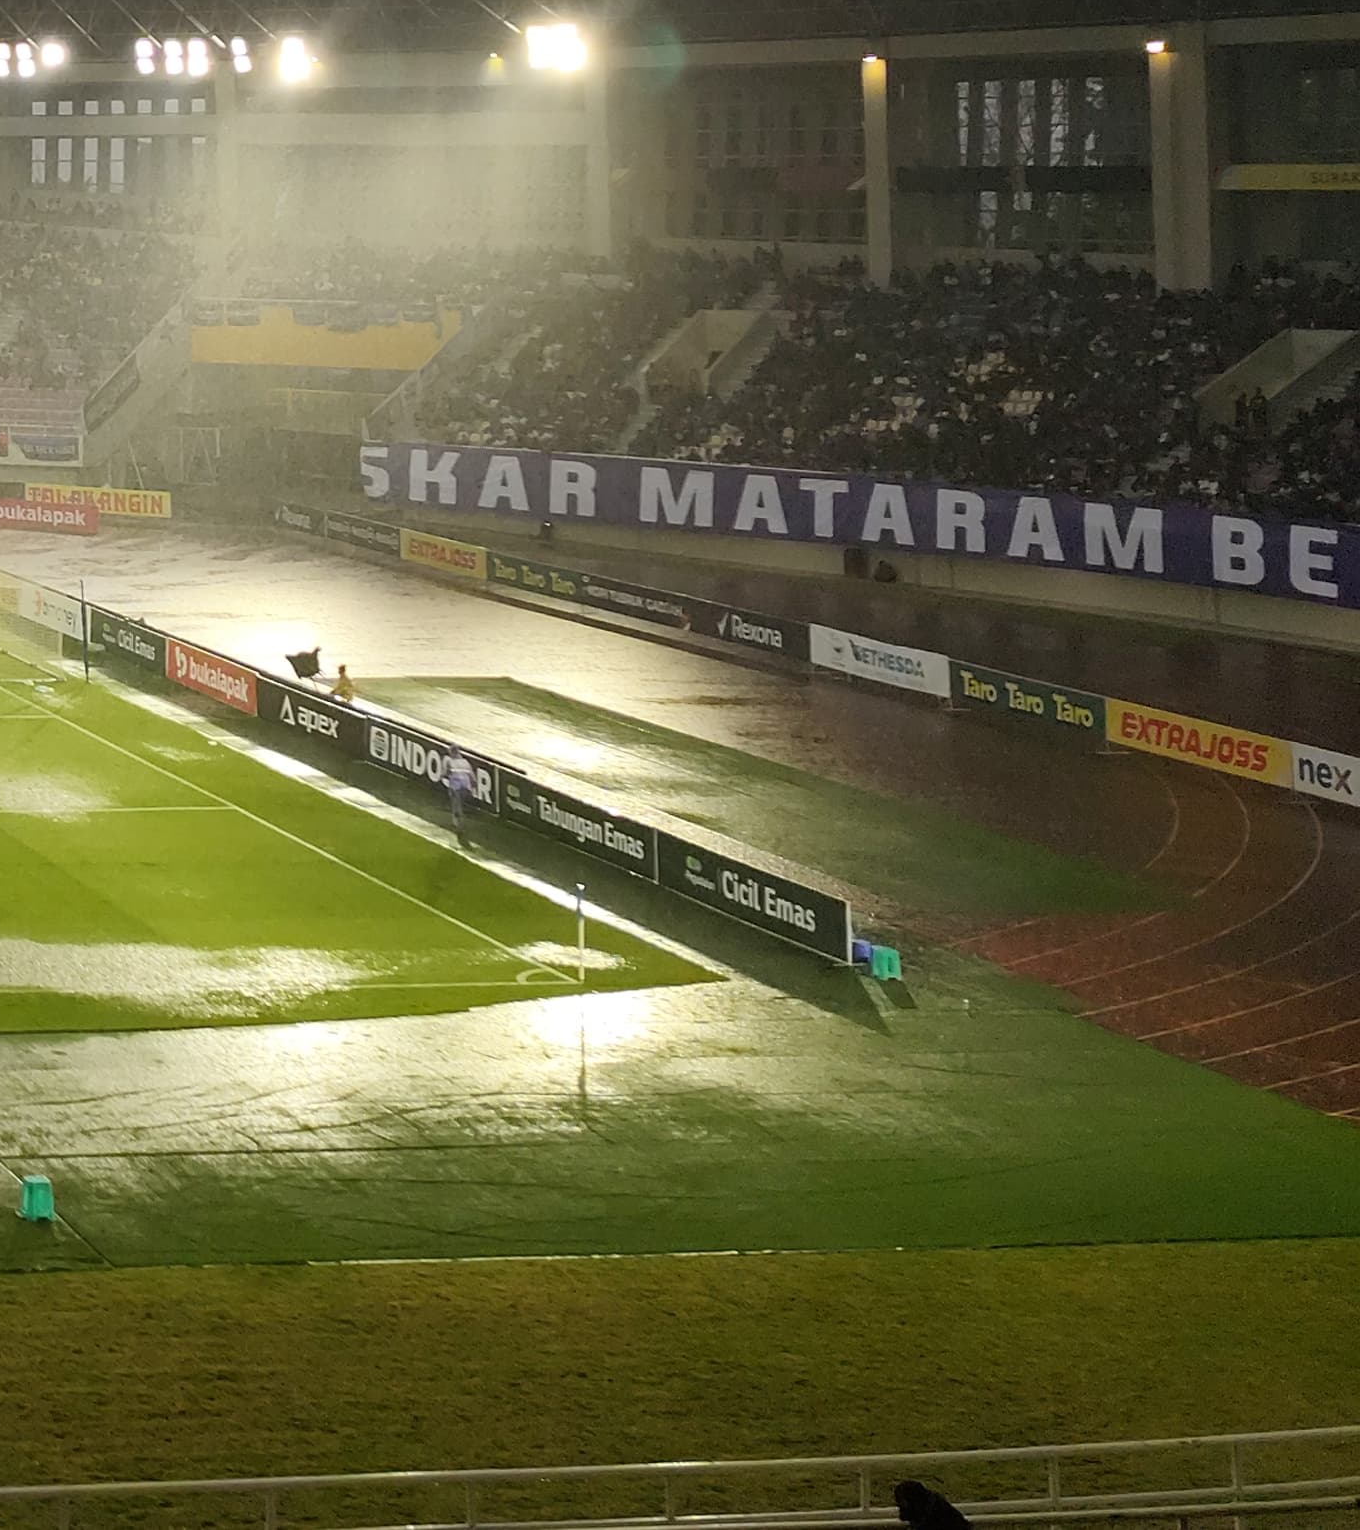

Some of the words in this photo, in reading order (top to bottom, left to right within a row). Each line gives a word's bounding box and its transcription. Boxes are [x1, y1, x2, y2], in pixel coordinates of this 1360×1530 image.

[640, 466, 1164, 573] MATARAM
[1211, 514, 1339, 599] BE
[117, 629, 134, 652] Cicil
[135, 635, 155, 661] Emas
[732, 615, 782, 648] Rexona
[189, 657, 248, 703] bukalapak
[959, 670, 997, 703] Taro
[1004, 682, 1044, 715] Taro
[1053, 693, 1094, 728] Taro
[298, 706, 339, 738] apex
[1120, 711, 1268, 772] EXTRAJOSS
[1298, 756, 1353, 795] nex
[536, 795, 603, 843] Tabungan
[603, 822, 644, 859] Emas
[722, 871, 761, 911] Cicil
[764, 886, 816, 932] Emas
